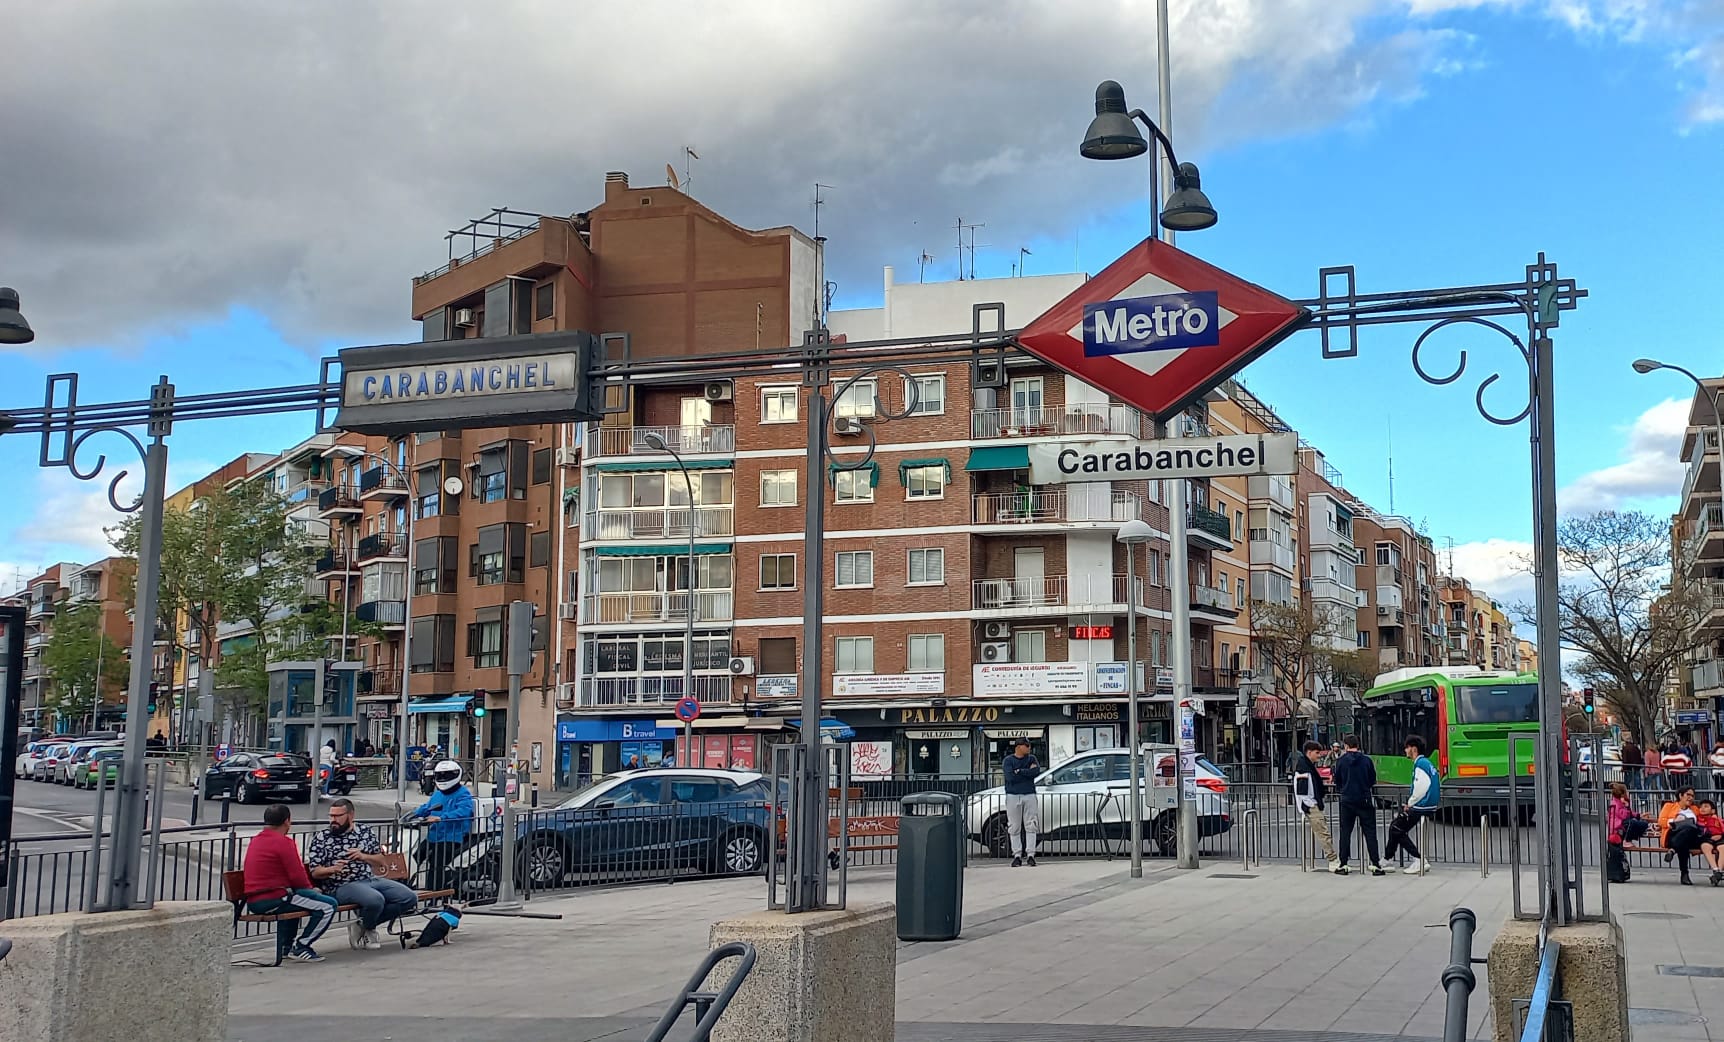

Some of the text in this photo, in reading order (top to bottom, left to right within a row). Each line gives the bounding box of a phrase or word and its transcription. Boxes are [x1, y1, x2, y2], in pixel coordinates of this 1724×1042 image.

[1094, 303, 1209, 344] Metro
[363, 361, 555, 400] CARABANCHEL
[1057, 440, 1265, 474] Carabanchel
[1075, 627, 1110, 638] FINCAS
[1077, 704, 1118, 712] HELADOS
[901, 707, 998, 723] PALAZZO
[1076, 712, 1119, 720] ITALIANOS
[622, 724, 656, 738] B travel
[921, 730, 953, 738] PALAZZO
[997, 729, 1029, 737] PALAZZO
